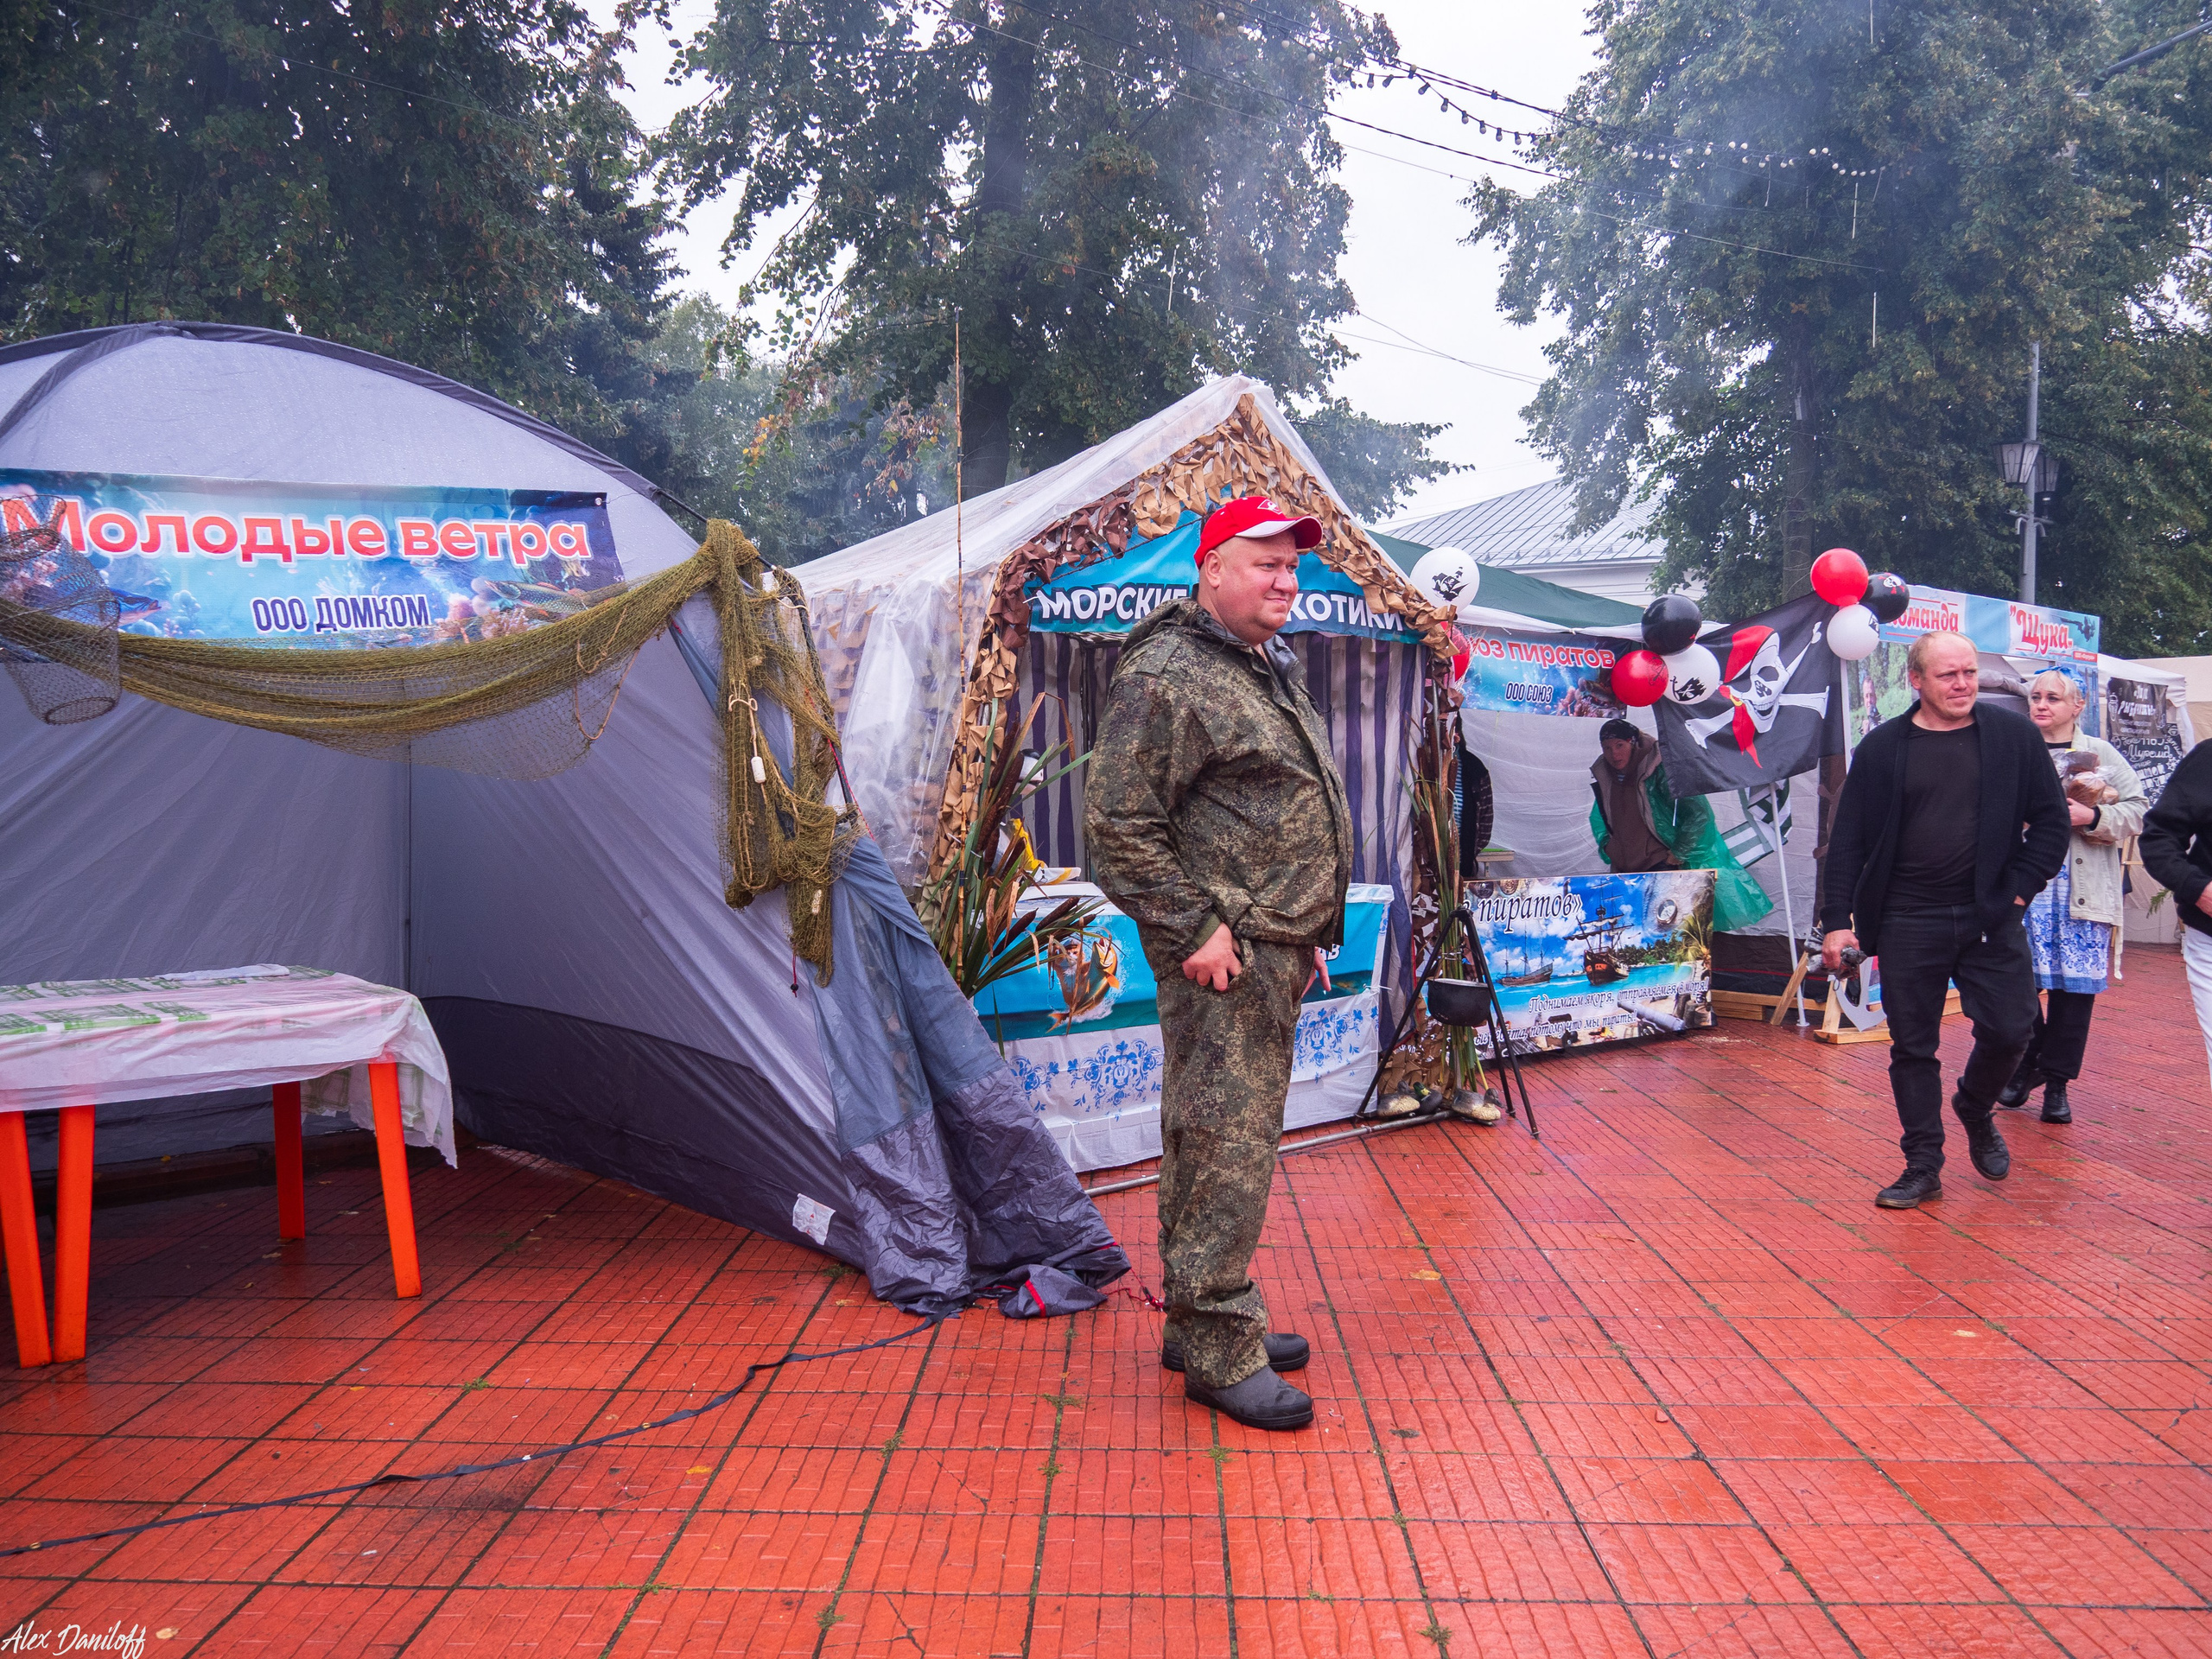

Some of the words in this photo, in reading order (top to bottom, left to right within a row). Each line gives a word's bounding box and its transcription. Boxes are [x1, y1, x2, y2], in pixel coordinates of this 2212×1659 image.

[3, 499, 385, 562] Молодые
[403, 518, 588, 563] ветра
[252, 598, 307, 632] ООО
[316, 595, 429, 632] ДОМКОМ
[1891, 603, 1959, 632] оманда
[1508, 642, 1615, 668] пиратов
[1507, 683, 1525, 701] ООО
[1526, 684, 1553, 702] СОЮЗ
[1529, 995, 1584, 1014] Поднимаем
[1618, 985, 1676, 1004] отправляемся
[1529, 1022, 1566, 1039] потому
[1566, 1021, 1582, 1032] что
[1584, 1019, 1599, 1030] мы
[1602, 1009, 1637, 1030] пираты!
